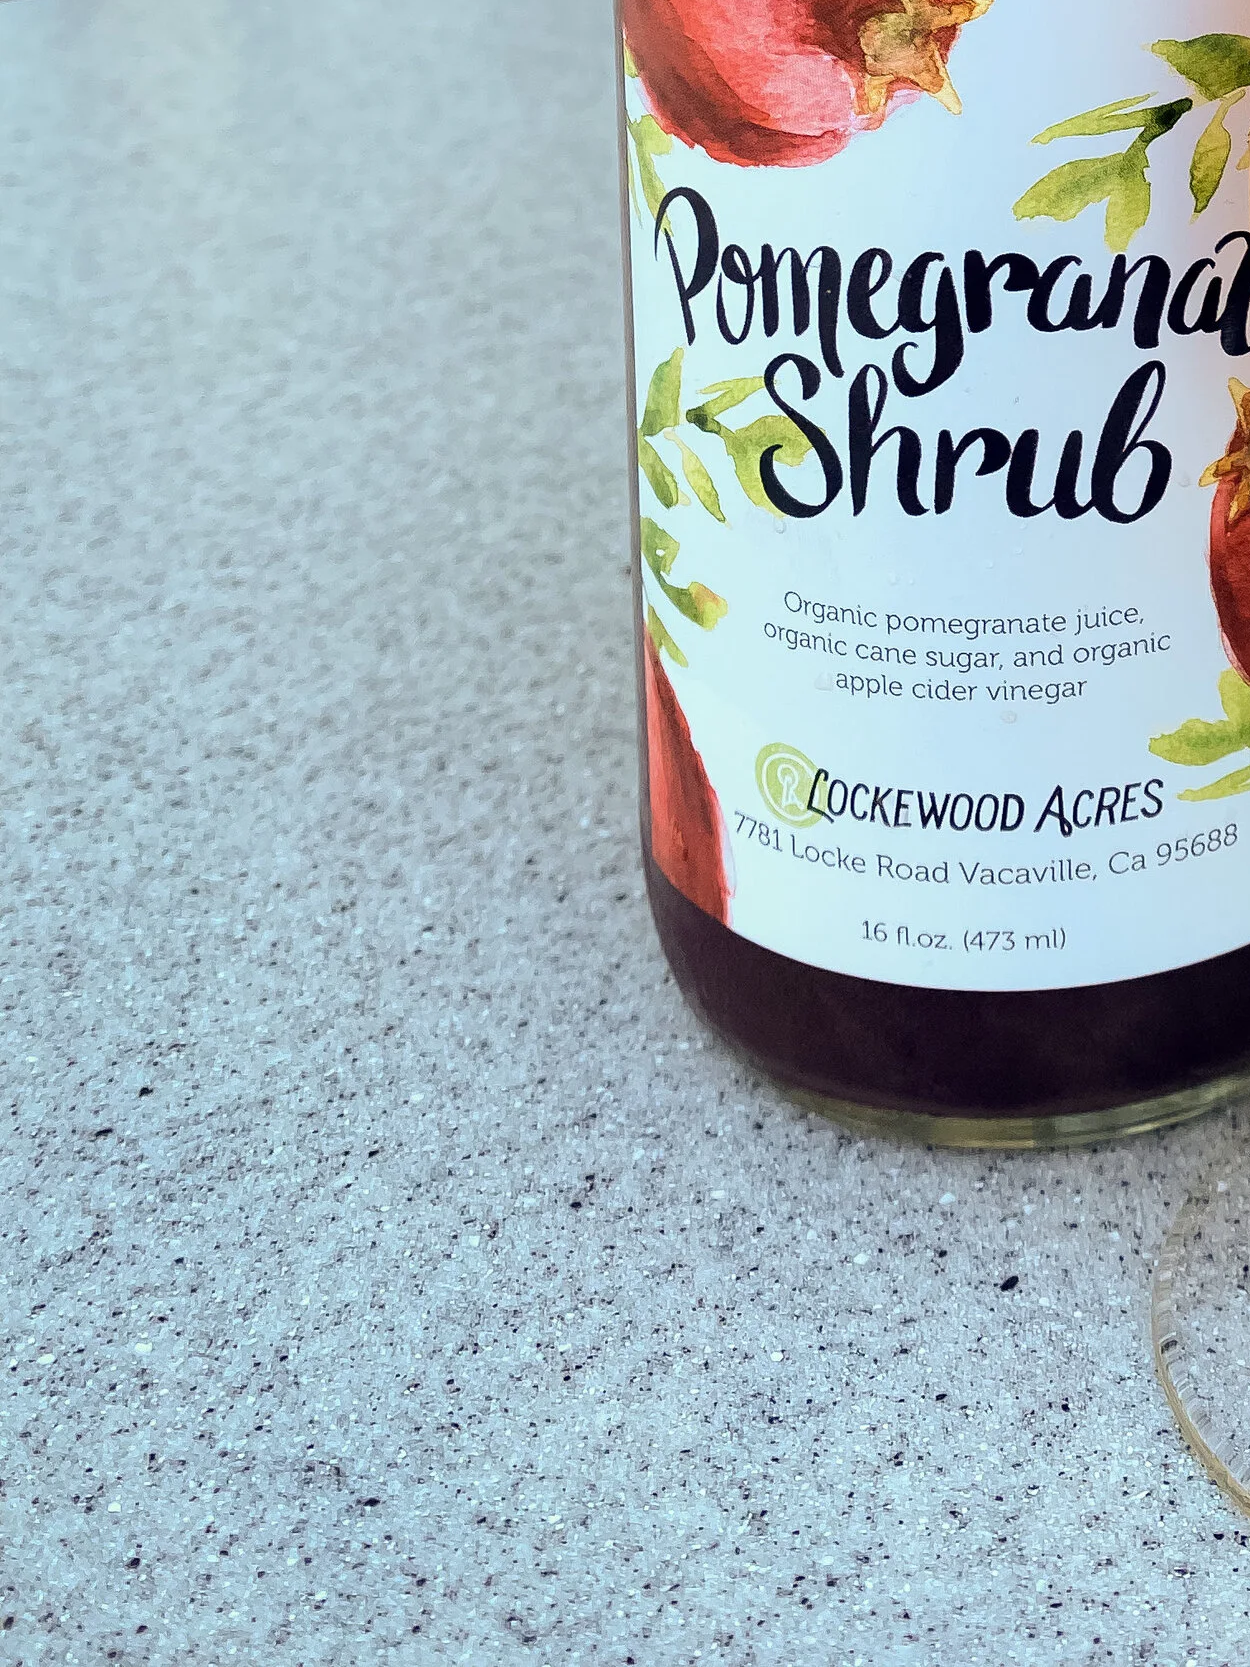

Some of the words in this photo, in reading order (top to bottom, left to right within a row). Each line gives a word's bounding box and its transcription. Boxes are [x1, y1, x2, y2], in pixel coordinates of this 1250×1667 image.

[759, 352, 1173, 524] Shrub
[784, 591, 877, 630] Organic
[886, 611, 1067, 640] pomegranate
[1073, 603, 1145, 636] juice,
[763, 620, 847, 656] organic
[855, 641, 917, 665] cane
[925, 649, 1005, 672] sugar,
[1013, 640, 1064, 669] and
[1072, 632, 1171, 666] organic
[835, 670, 903, 700] apple
[912, 678, 977, 702] cider
[986, 677, 1087, 705] vinegar
[806, 768, 1025, 833] LOCKEWOOD
[1034, 779, 1164, 837] ACRES
[734, 810, 783, 852] 7781
[791, 835, 866, 876] Locke
[877, 855, 949, 885] Road
[959, 858, 1098, 886] Vacaville,
[1108, 851, 1147, 876] Ca
[1156, 822, 1240, 868] 95688
[861, 920, 888, 943] 16
[963, 928, 1016, 952] (473
[1025, 928, 1067, 951] ml)
